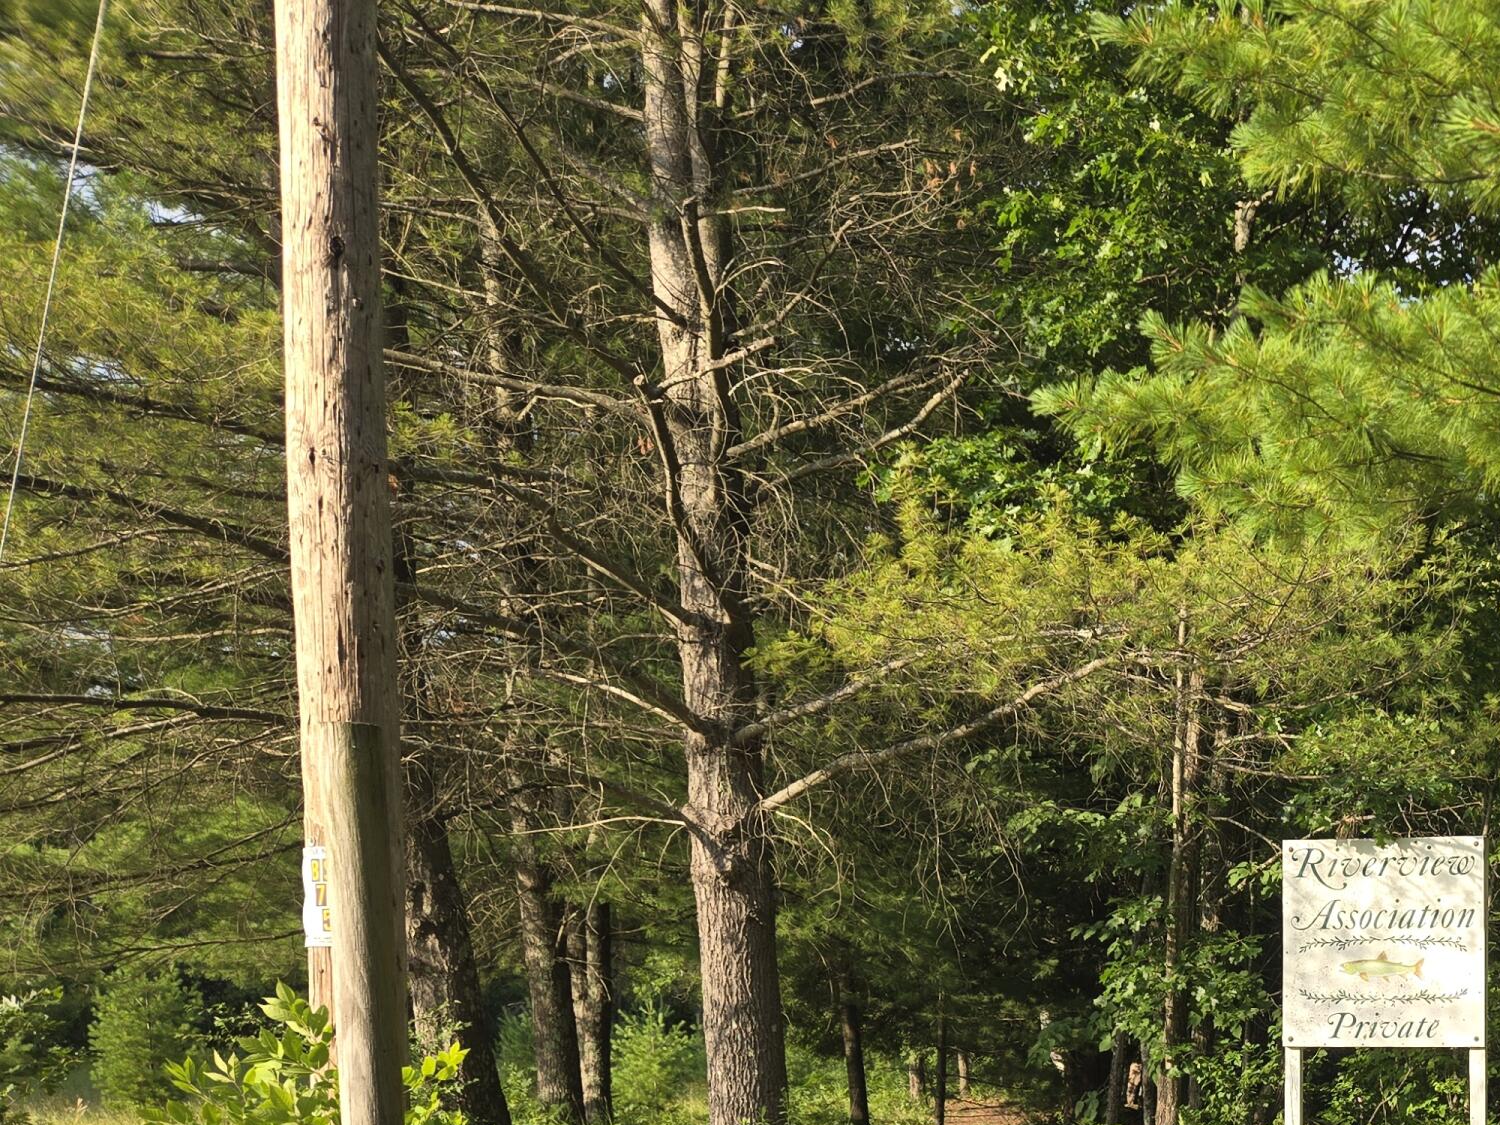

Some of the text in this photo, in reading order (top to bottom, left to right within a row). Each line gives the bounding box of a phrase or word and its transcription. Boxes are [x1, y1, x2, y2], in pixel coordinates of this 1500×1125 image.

[1291, 848, 1475, 890] Riverview
[1290, 899, 1476, 931] Association
[1327, 1012, 1440, 1039] Private
